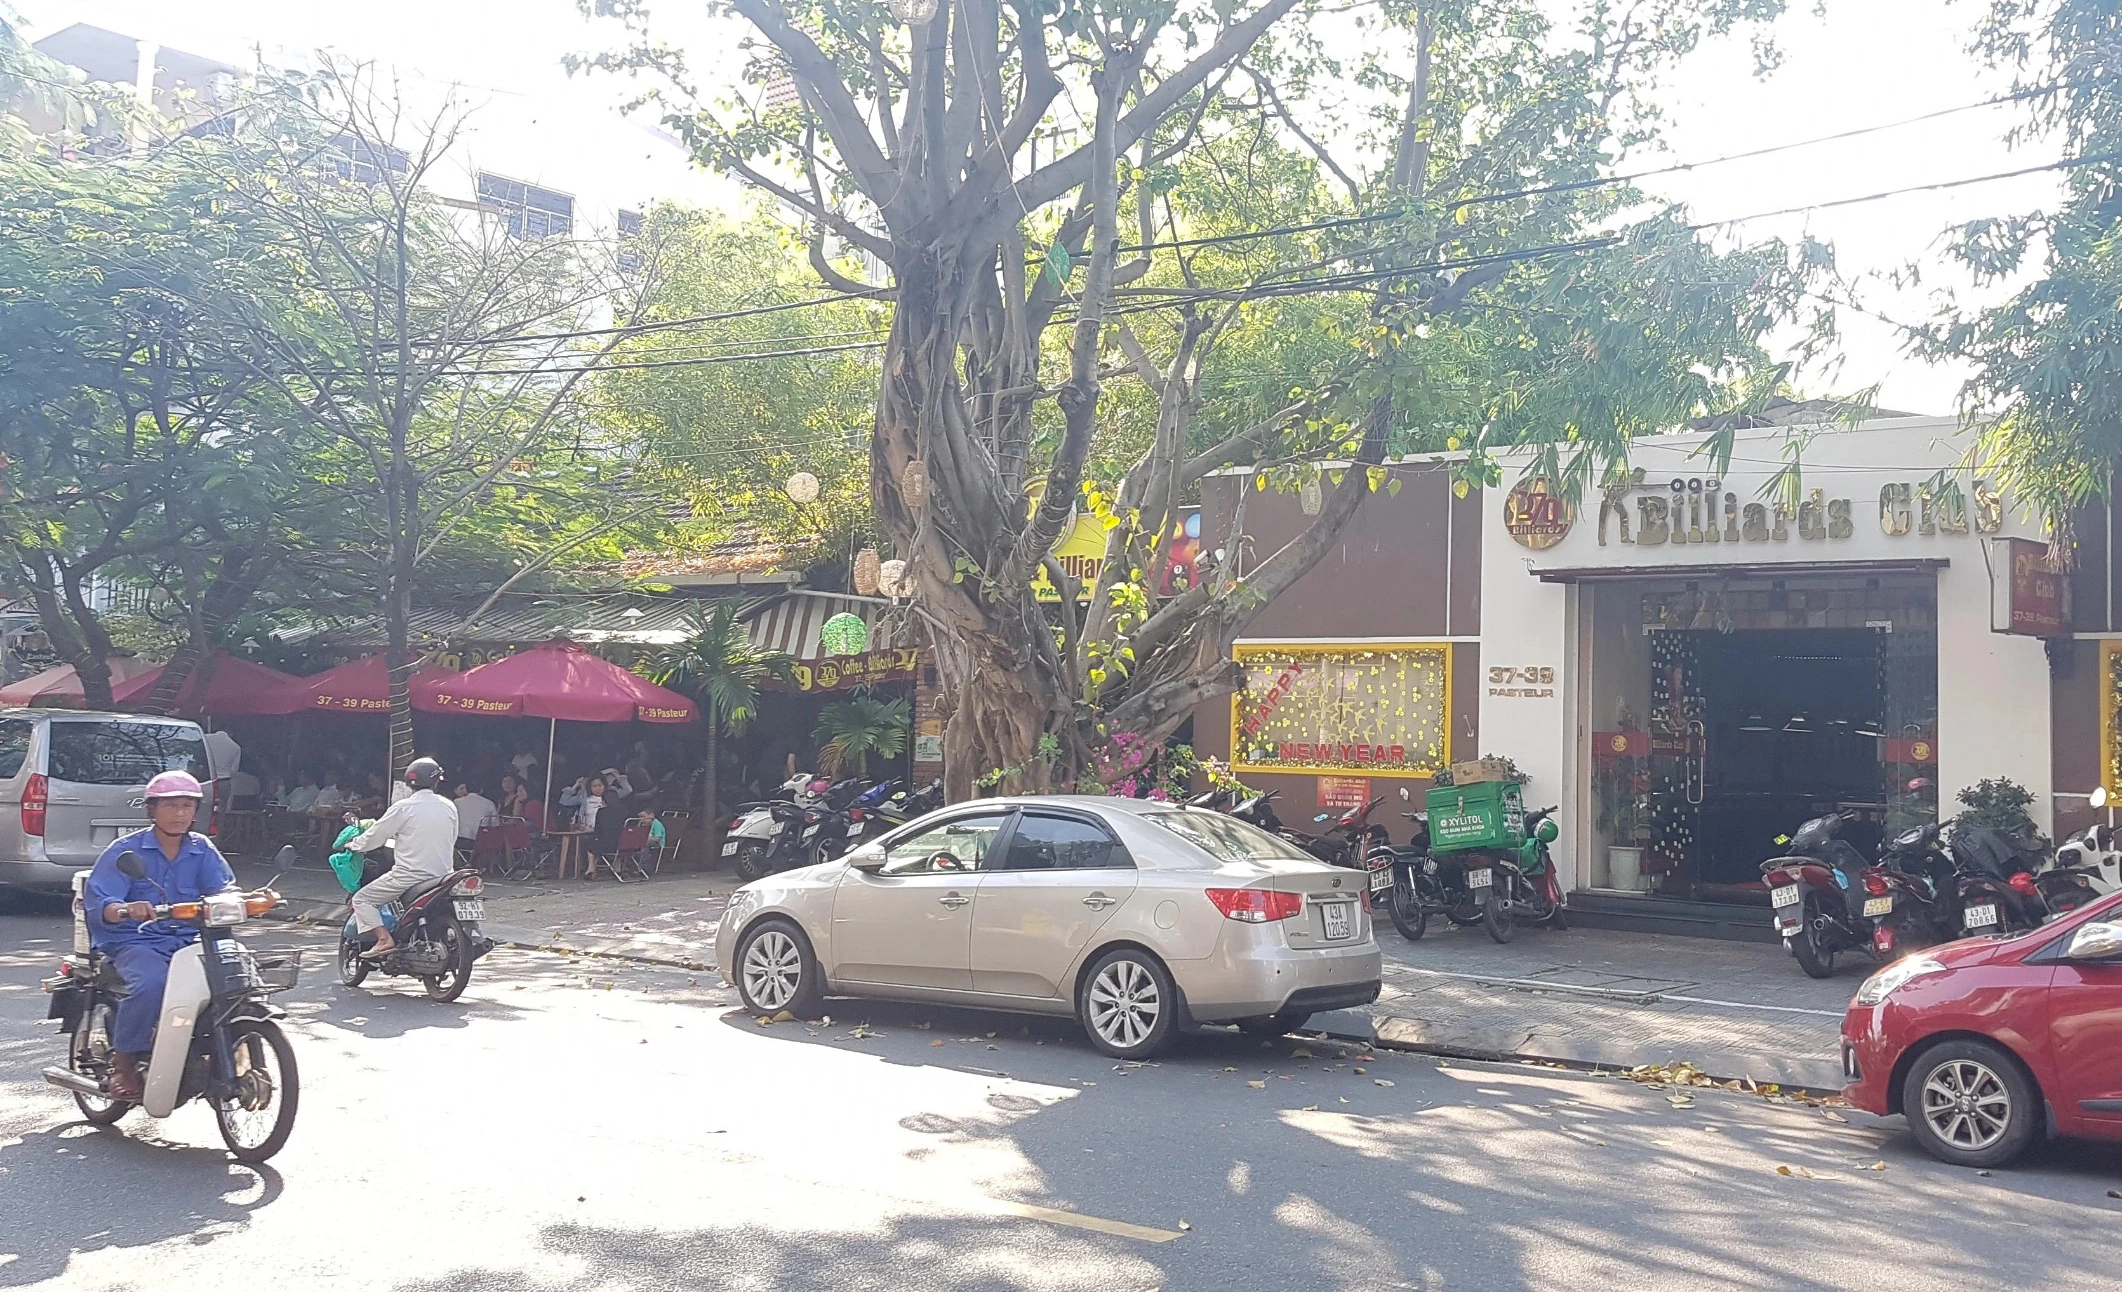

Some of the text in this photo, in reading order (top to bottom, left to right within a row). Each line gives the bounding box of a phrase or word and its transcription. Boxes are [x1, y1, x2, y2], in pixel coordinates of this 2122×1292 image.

[1488, 666, 1554, 684] 37-39
[1243, 661, 1302, 737] HAPPY
[1488, 688, 1554, 698] PASTEUR
[317, 695, 332, 705] 37
[342, 697, 357, 708] 39
[437, 694, 451, 705] 37
[461, 698, 475, 709] 39
[477, 700, 512, 711] Pasteur
[657, 709, 688, 718] Pasteur
[1279, 742, 1405, 762] NEW YEAR
[1449, 815, 1483, 827] XYLITOL
[1329, 905, 1343, 920] 43A
